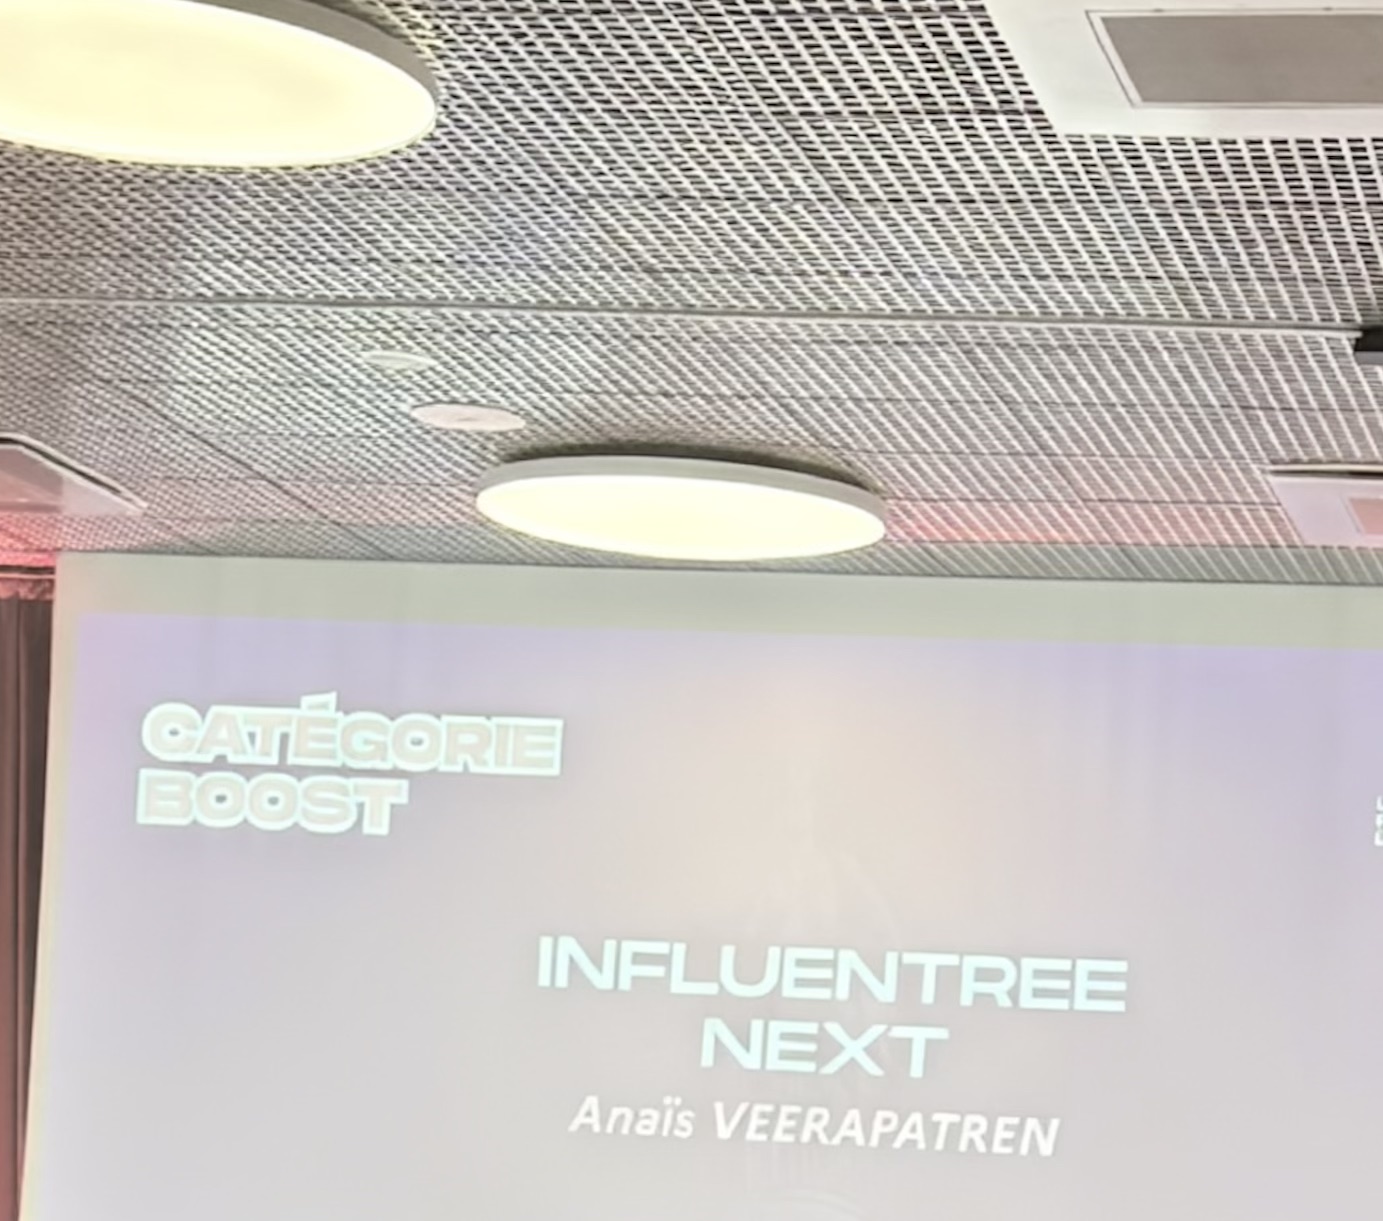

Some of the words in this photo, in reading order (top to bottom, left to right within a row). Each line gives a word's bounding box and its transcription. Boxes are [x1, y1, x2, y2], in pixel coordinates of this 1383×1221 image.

[142, 691, 564, 776] CATÉGORIE
[136, 768, 409, 835] BOOST
[537, 935, 1129, 1012] INFLUENTREE
[700, 1017, 950, 1079] NEXT
[568, 1094, 696, 1139] Anaïs
[712, 1100, 1062, 1158] VEERAPATREN
